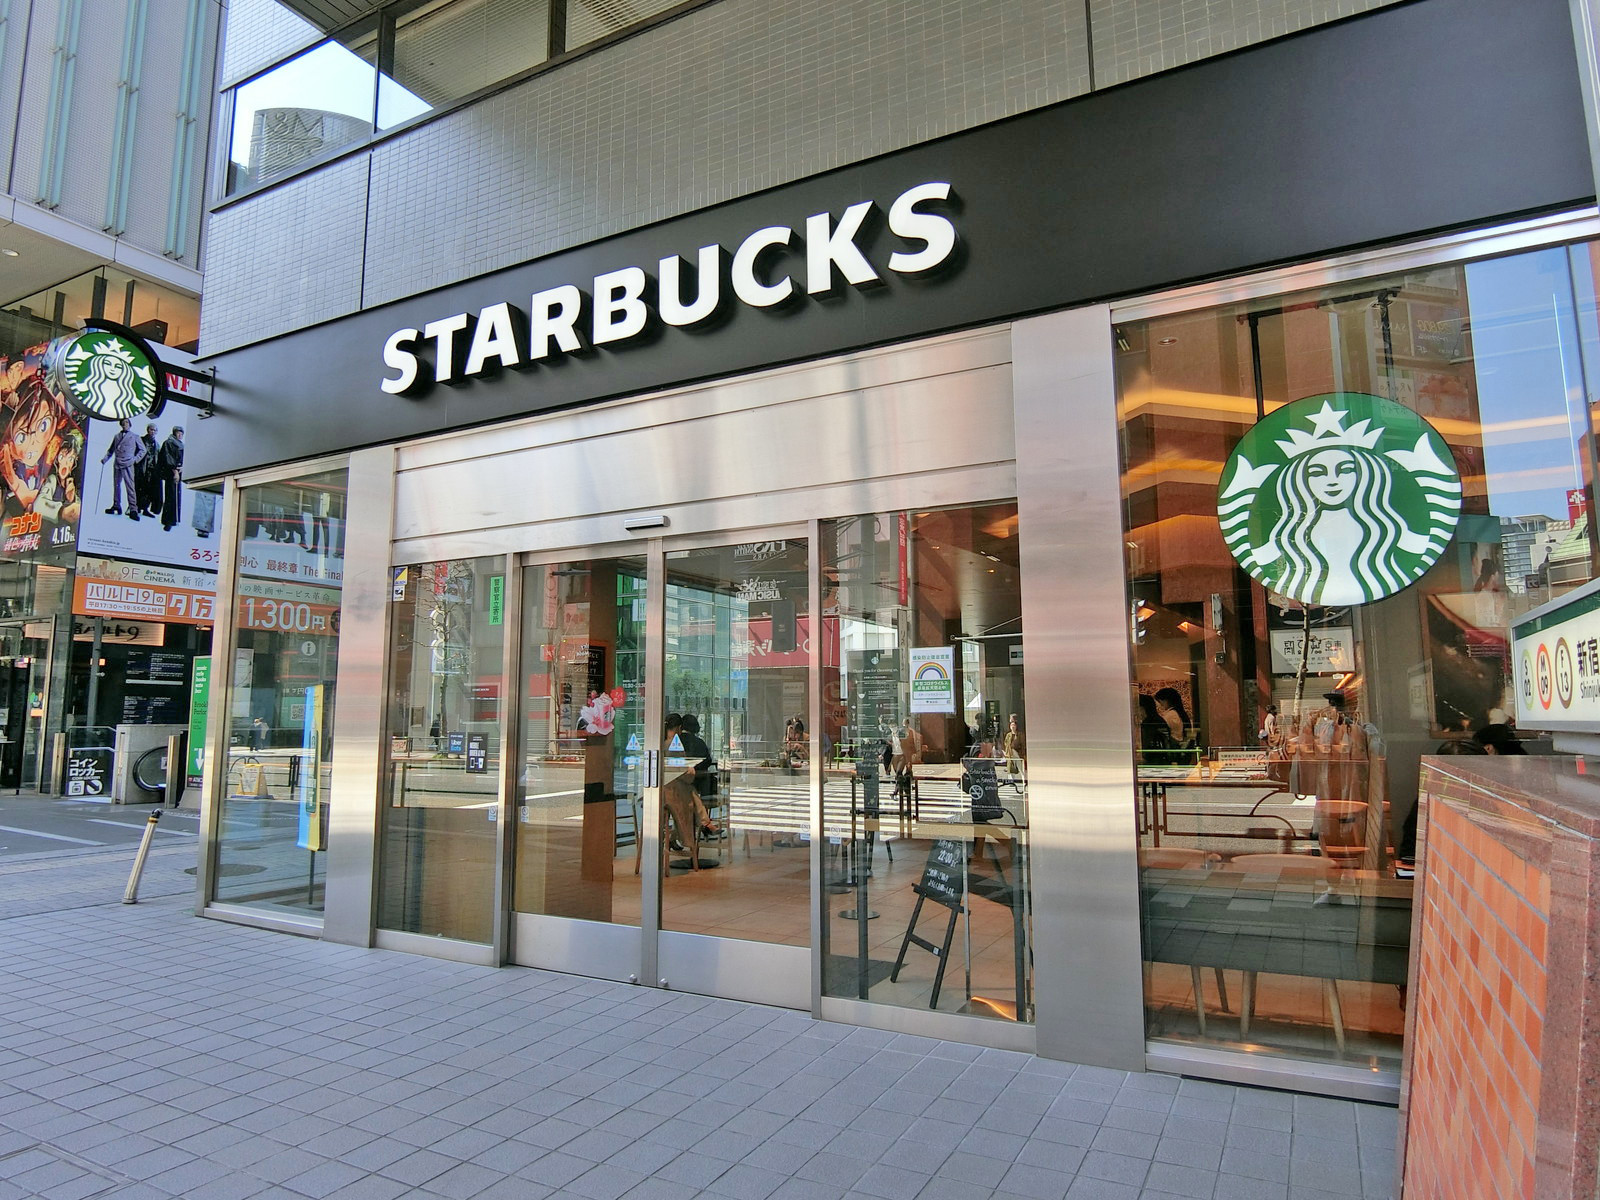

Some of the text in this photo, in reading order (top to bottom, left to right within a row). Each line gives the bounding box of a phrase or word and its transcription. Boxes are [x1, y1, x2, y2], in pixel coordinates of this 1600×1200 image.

[380, 182, 960, 395] STARBUCKS
[121, 566, 140, 579] 9F
[266, 560, 298, 574] 最終章
[303, 565, 318, 577] The
[143, 575, 176, 585] CINEMA
[89, 585, 164, 603] バルト9の
[1523, 679, 1531, 697] 02
[1541, 675, 1548, 695] 09
[1560, 671, 1569, 693] 13
[69, 766, 104, 777] ロッカー
[70, 758, 98, 768] コイン
